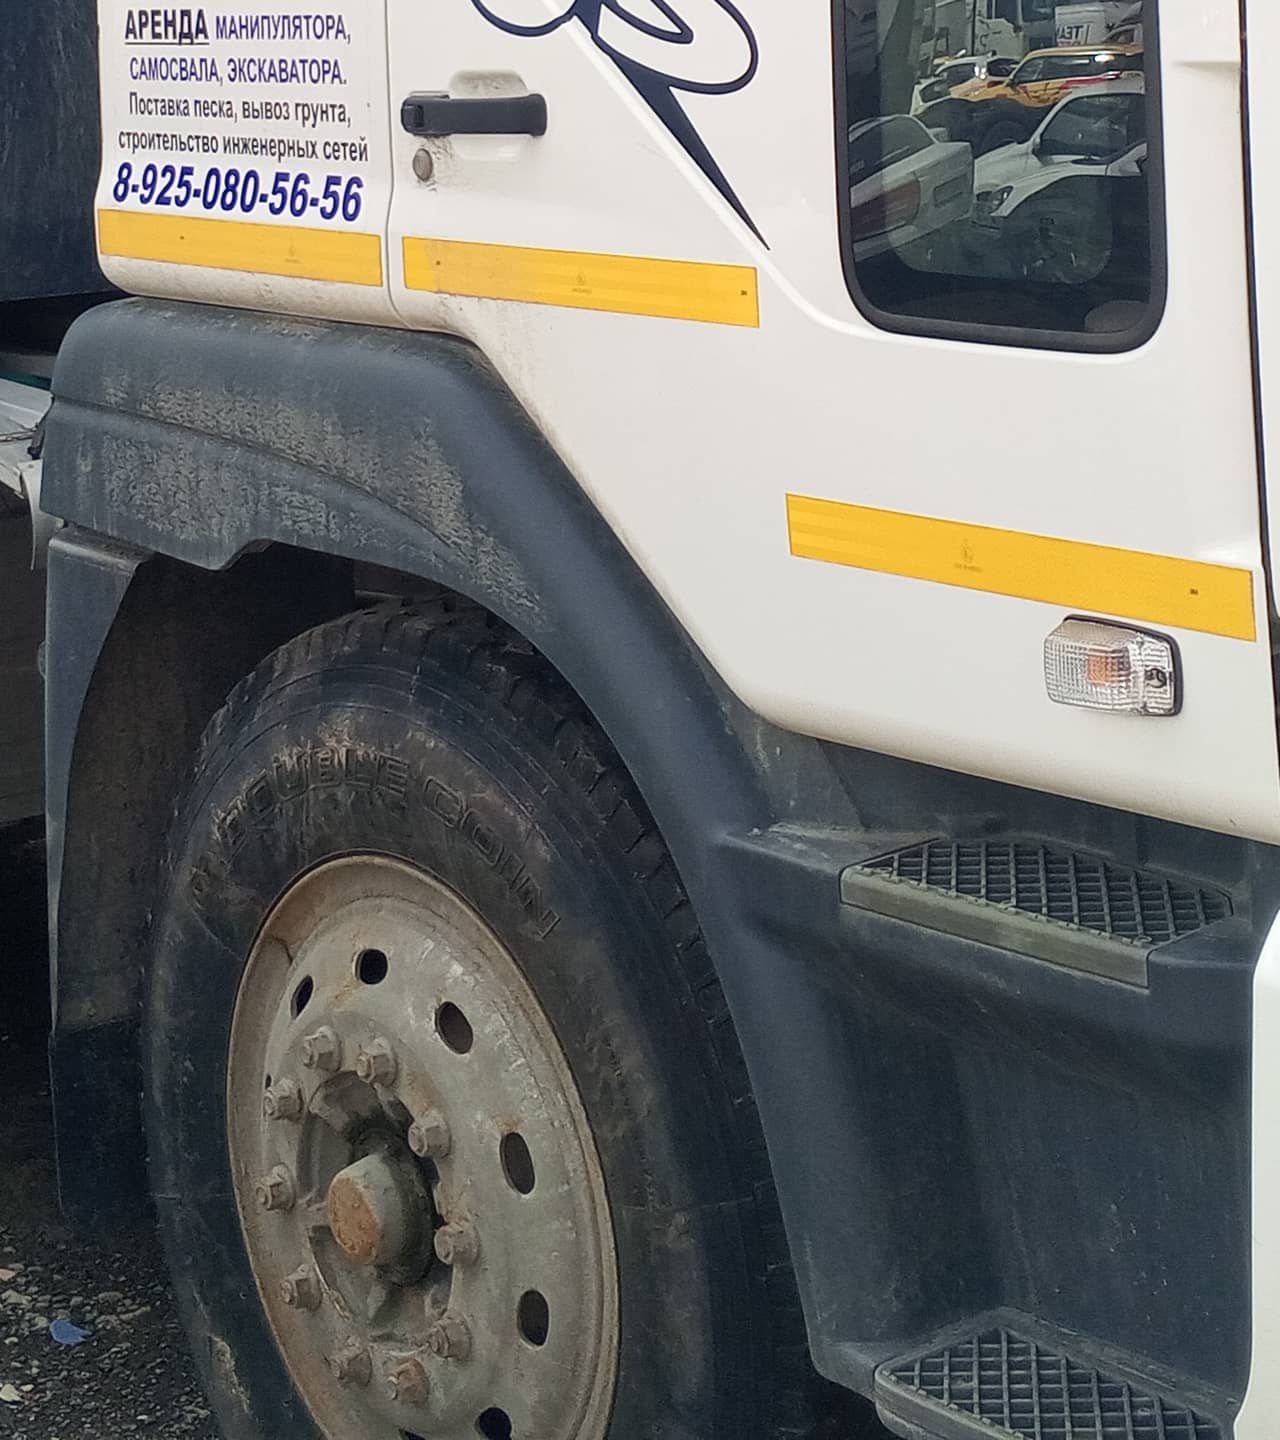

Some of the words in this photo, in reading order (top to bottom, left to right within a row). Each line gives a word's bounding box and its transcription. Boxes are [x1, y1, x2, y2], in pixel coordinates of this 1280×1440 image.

[124, 9, 210, 45] АРЕНДА
[215, 14, 352, 44] МАНИПУЛЯТОРА,
[129, 56, 224, 86] САМОСВАЛА,
[227, 58, 348, 85] ЭКСКАВАТОРА.
[129, 92, 191, 118] Поставка
[194, 99, 239, 124] песка,
[242, 100, 291, 121] вывоз
[295, 102, 352, 128] грунта,
[118, 129, 219, 155] строительство
[222, 135, 319, 163] инженерных
[322, 137, 369, 162] сетей
[112, 161, 365, 223] 8-925-080-56-56
